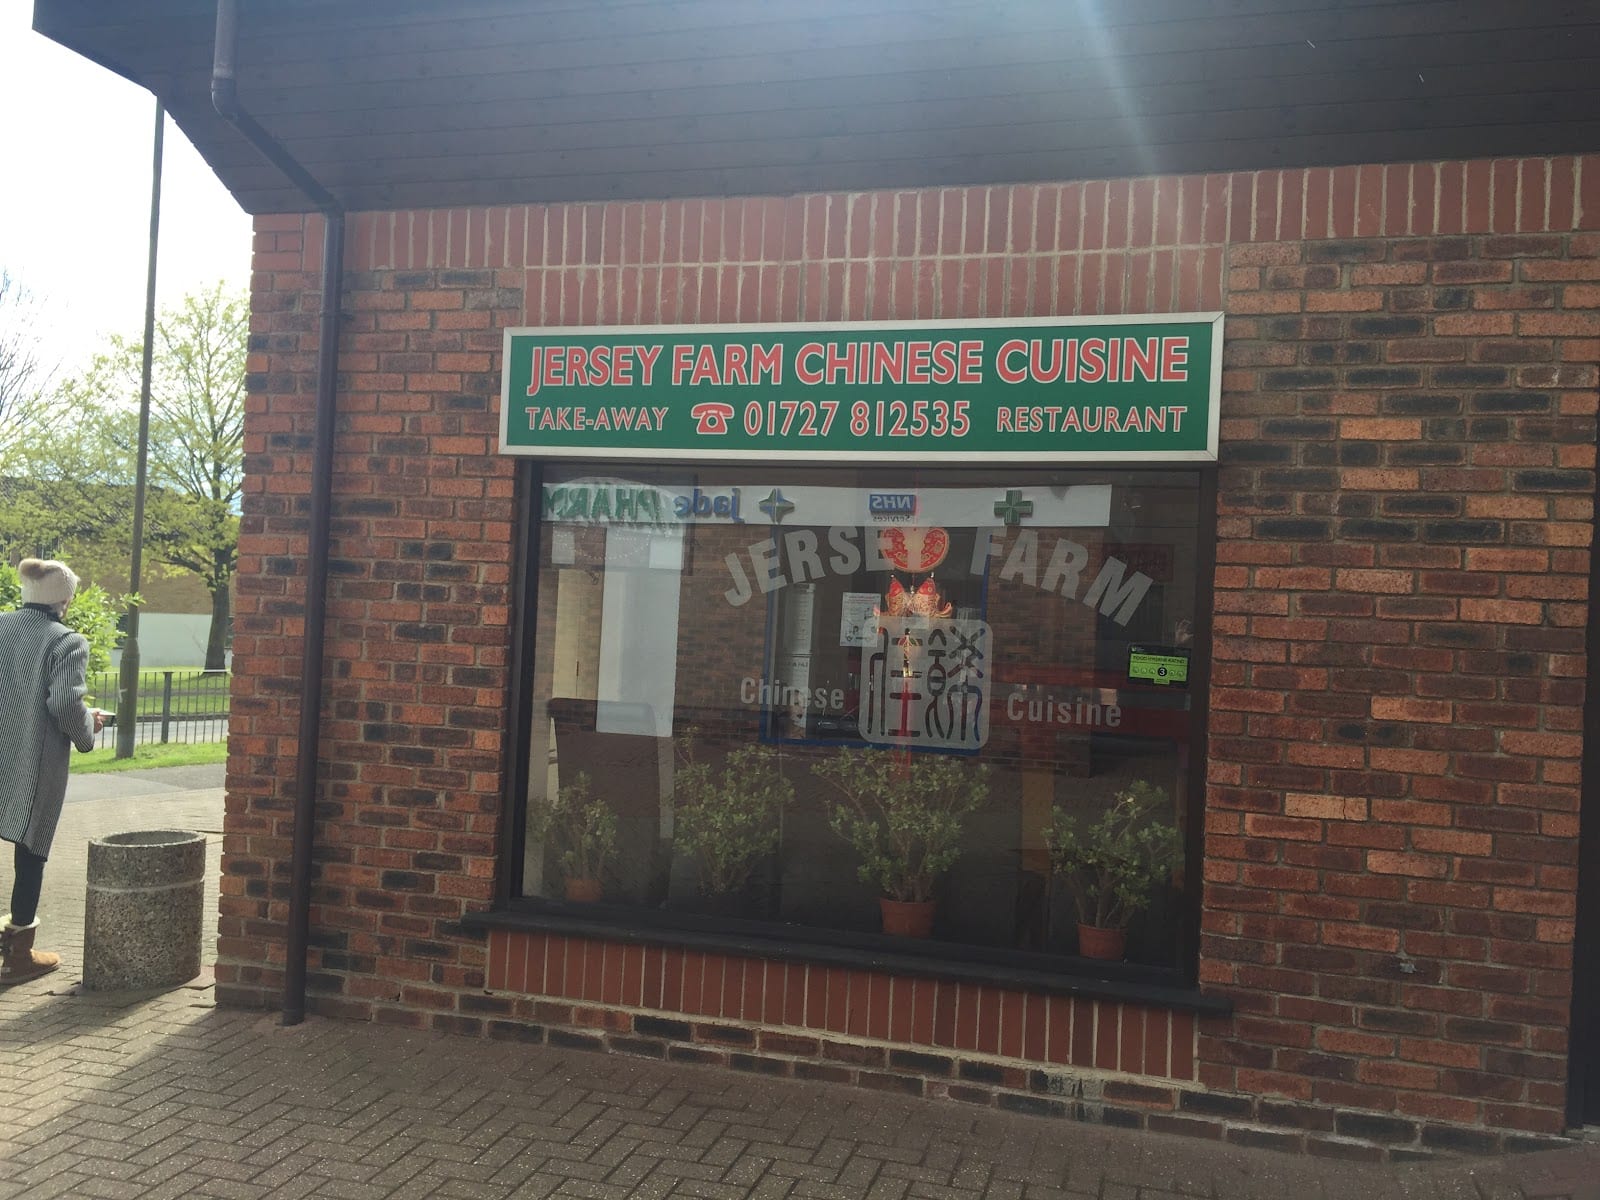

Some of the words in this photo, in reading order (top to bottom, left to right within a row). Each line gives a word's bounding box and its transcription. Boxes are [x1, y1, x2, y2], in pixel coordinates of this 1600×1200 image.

[526, 345, 663, 396] JERSEY
[671, 343, 783, 385] FARM
[795, 340, 984, 385] CHINESE
[995, 336, 1190, 384] CUISINE
[525, 407, 669, 431] TAKE-AWAY
[743, 401, 839, 436] 01727
[850, 400, 971, 437] 812535
[996, 406, 1188, 433] RESTAURANT
[970, 520, 1154, 627] FARM
[1159, 668, 1166, 676] 3
[740, 677, 844, 710] Chinese
[1007, 692, 1121, 727] Cuisine
